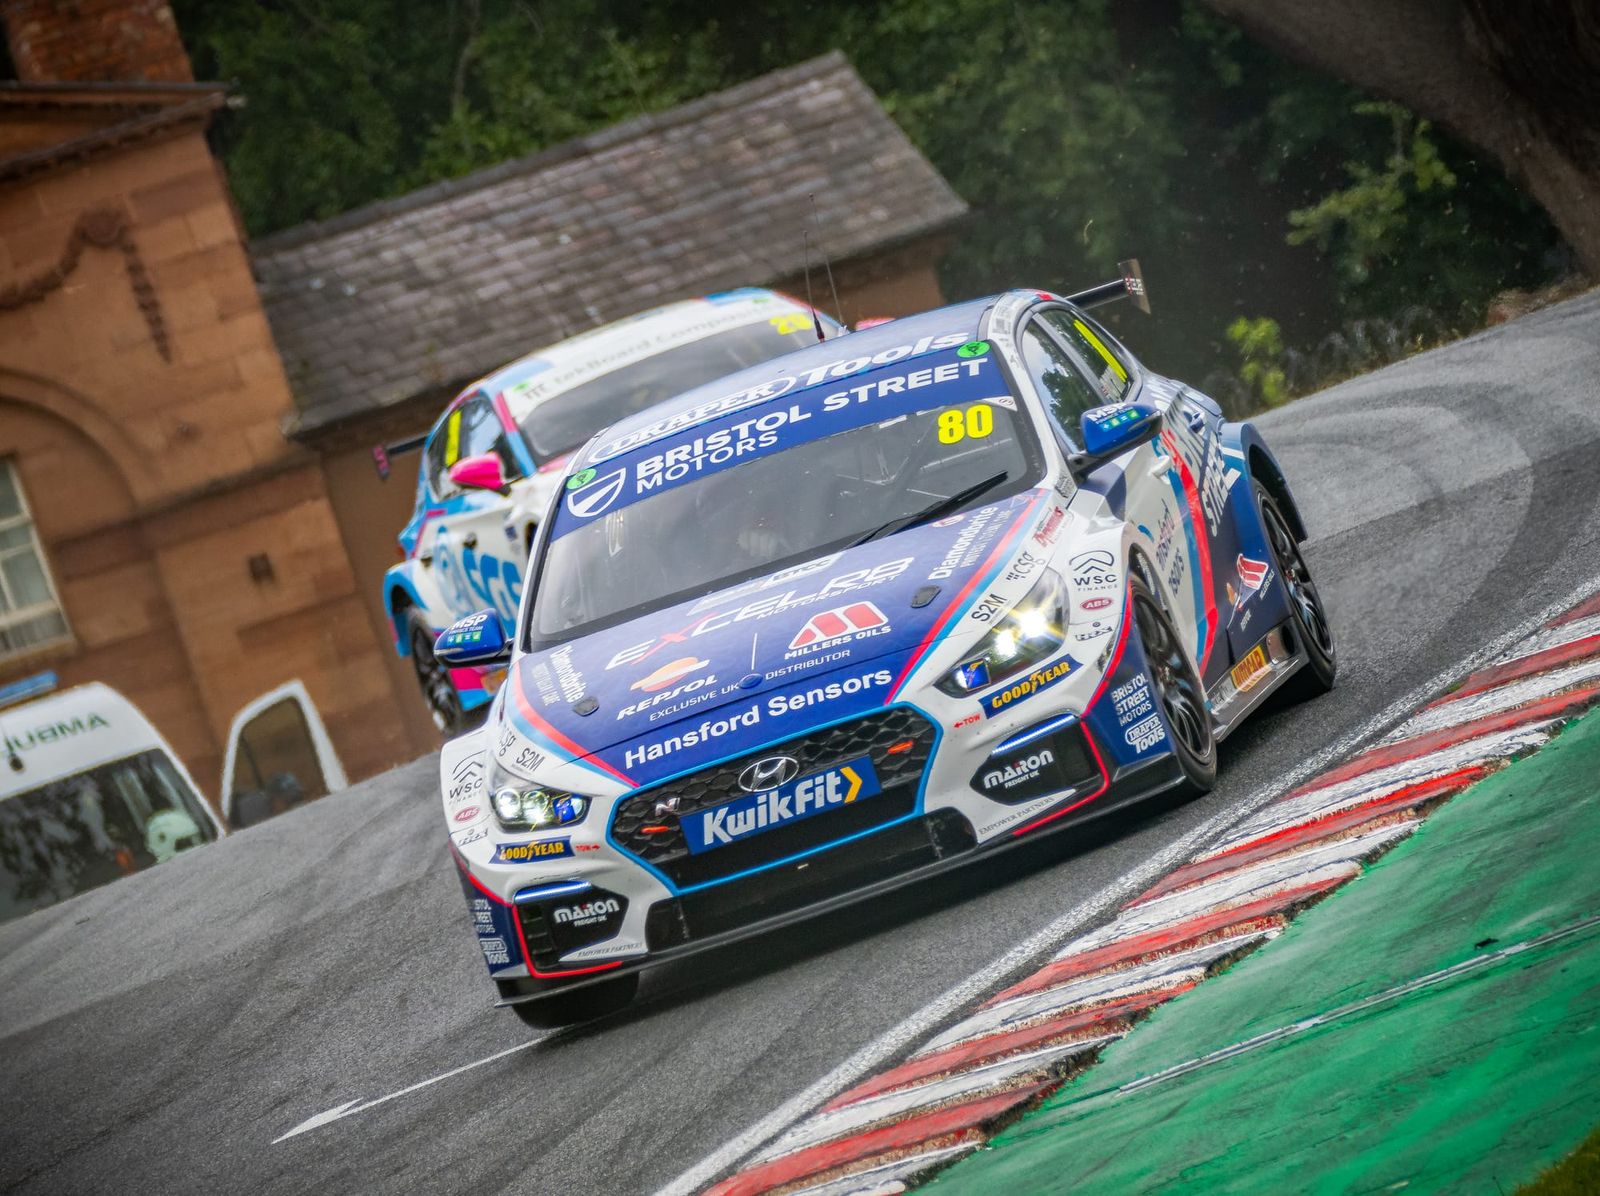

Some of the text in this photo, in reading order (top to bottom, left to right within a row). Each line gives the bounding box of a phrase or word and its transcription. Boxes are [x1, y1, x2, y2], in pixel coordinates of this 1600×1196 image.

[606, 332, 970, 456] DRAPER Tools
[636, 357, 988, 480] BRISTOL STREET
[937, 403, 994, 445] 80
[636, 430, 778, 494] MOTORS
[927, 505, 1000, 581] Diamondbrite
[756, 572, 905, 621] MOTORSPORT
[1073, 574, 1117, 586] WSC
[604, 556, 915, 671] EXCELR8
[971, 593, 1007, 622] S2M
[1085, 597, 1110, 609] ABS
[784, 625, 892, 660] MILLERS OILS
[616, 674, 718, 721] REPSOL
[650, 649, 851, 722] EXCLUSIVE UK DISTRIBUTOR
[1111, 673, 1148, 704] BRISTOL
[1115, 685, 1150, 715] STREET
[625, 670, 892, 769] Hansford Sensors
[963, 713, 981, 725] TOW
[1119, 700, 1152, 726] MOTORS
[1128, 716, 1161, 741] DRAPER
[516, 747, 546, 772] S2M
[449, 778, 482, 799] WSC
[978, 796, 1055, 836] EMPOWER PARTNERS
